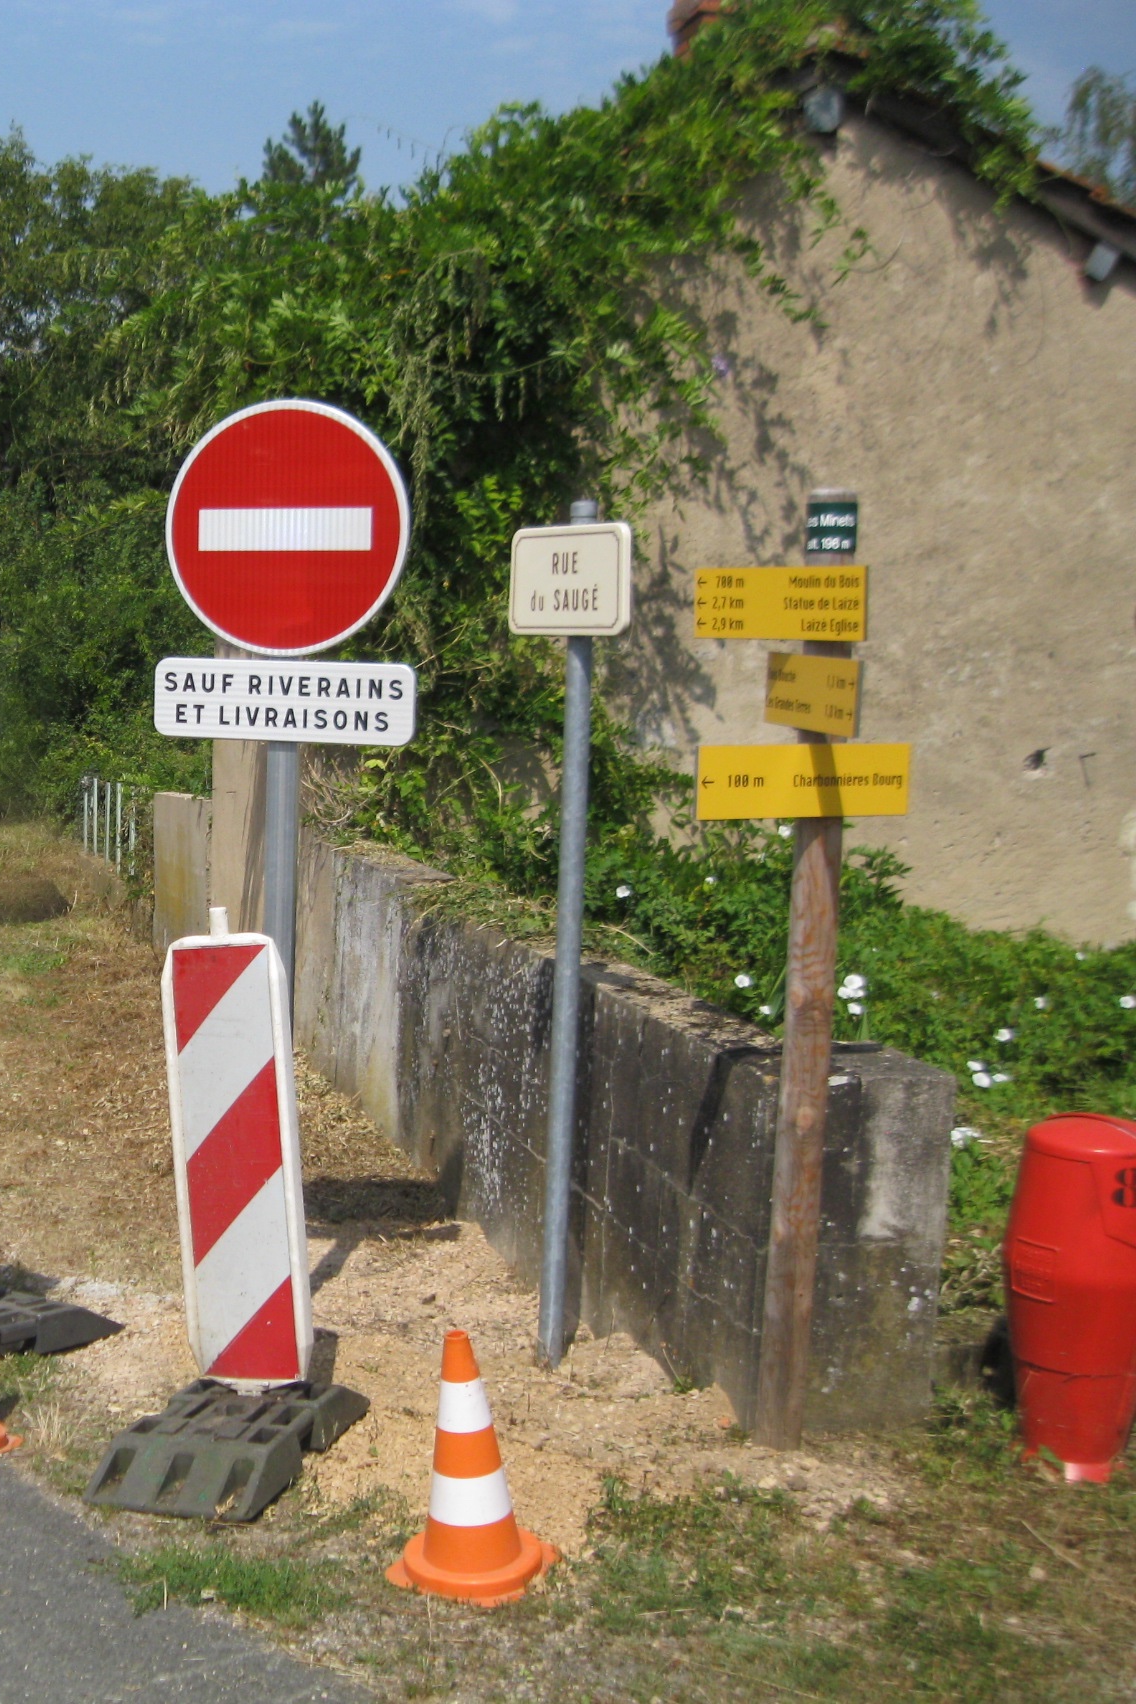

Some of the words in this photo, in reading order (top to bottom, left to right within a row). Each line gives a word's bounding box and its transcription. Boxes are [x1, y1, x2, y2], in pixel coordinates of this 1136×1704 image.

[552, 551, 578, 575] RUE
[715, 575, 733, 589] 700
[735, 578, 744, 588] m
[788, 575, 821, 588] Moulin
[824, 575, 836, 588] du
[838, 574, 859, 588] Bois
[530, 590, 544, 611] du
[553, 584, 599, 611] SAUGÉ
[712, 596, 727, 611] 2,7
[729, 596, 744, 609] km
[783, 597, 815, 610] Statue
[818, 597, 829, 610] de
[712, 617, 726, 631] 2,9
[729, 617, 744, 630] km
[164, 672, 234, 694] SAUF
[248, 674, 403, 700] RIVERAINS
[175, 703, 205, 724] ET
[219, 705, 389, 732] LIVRAISONS
[727, 774, 749, 788] 100
[753, 776, 764, 788] m
[872, 773, 903, 790] Bourg
